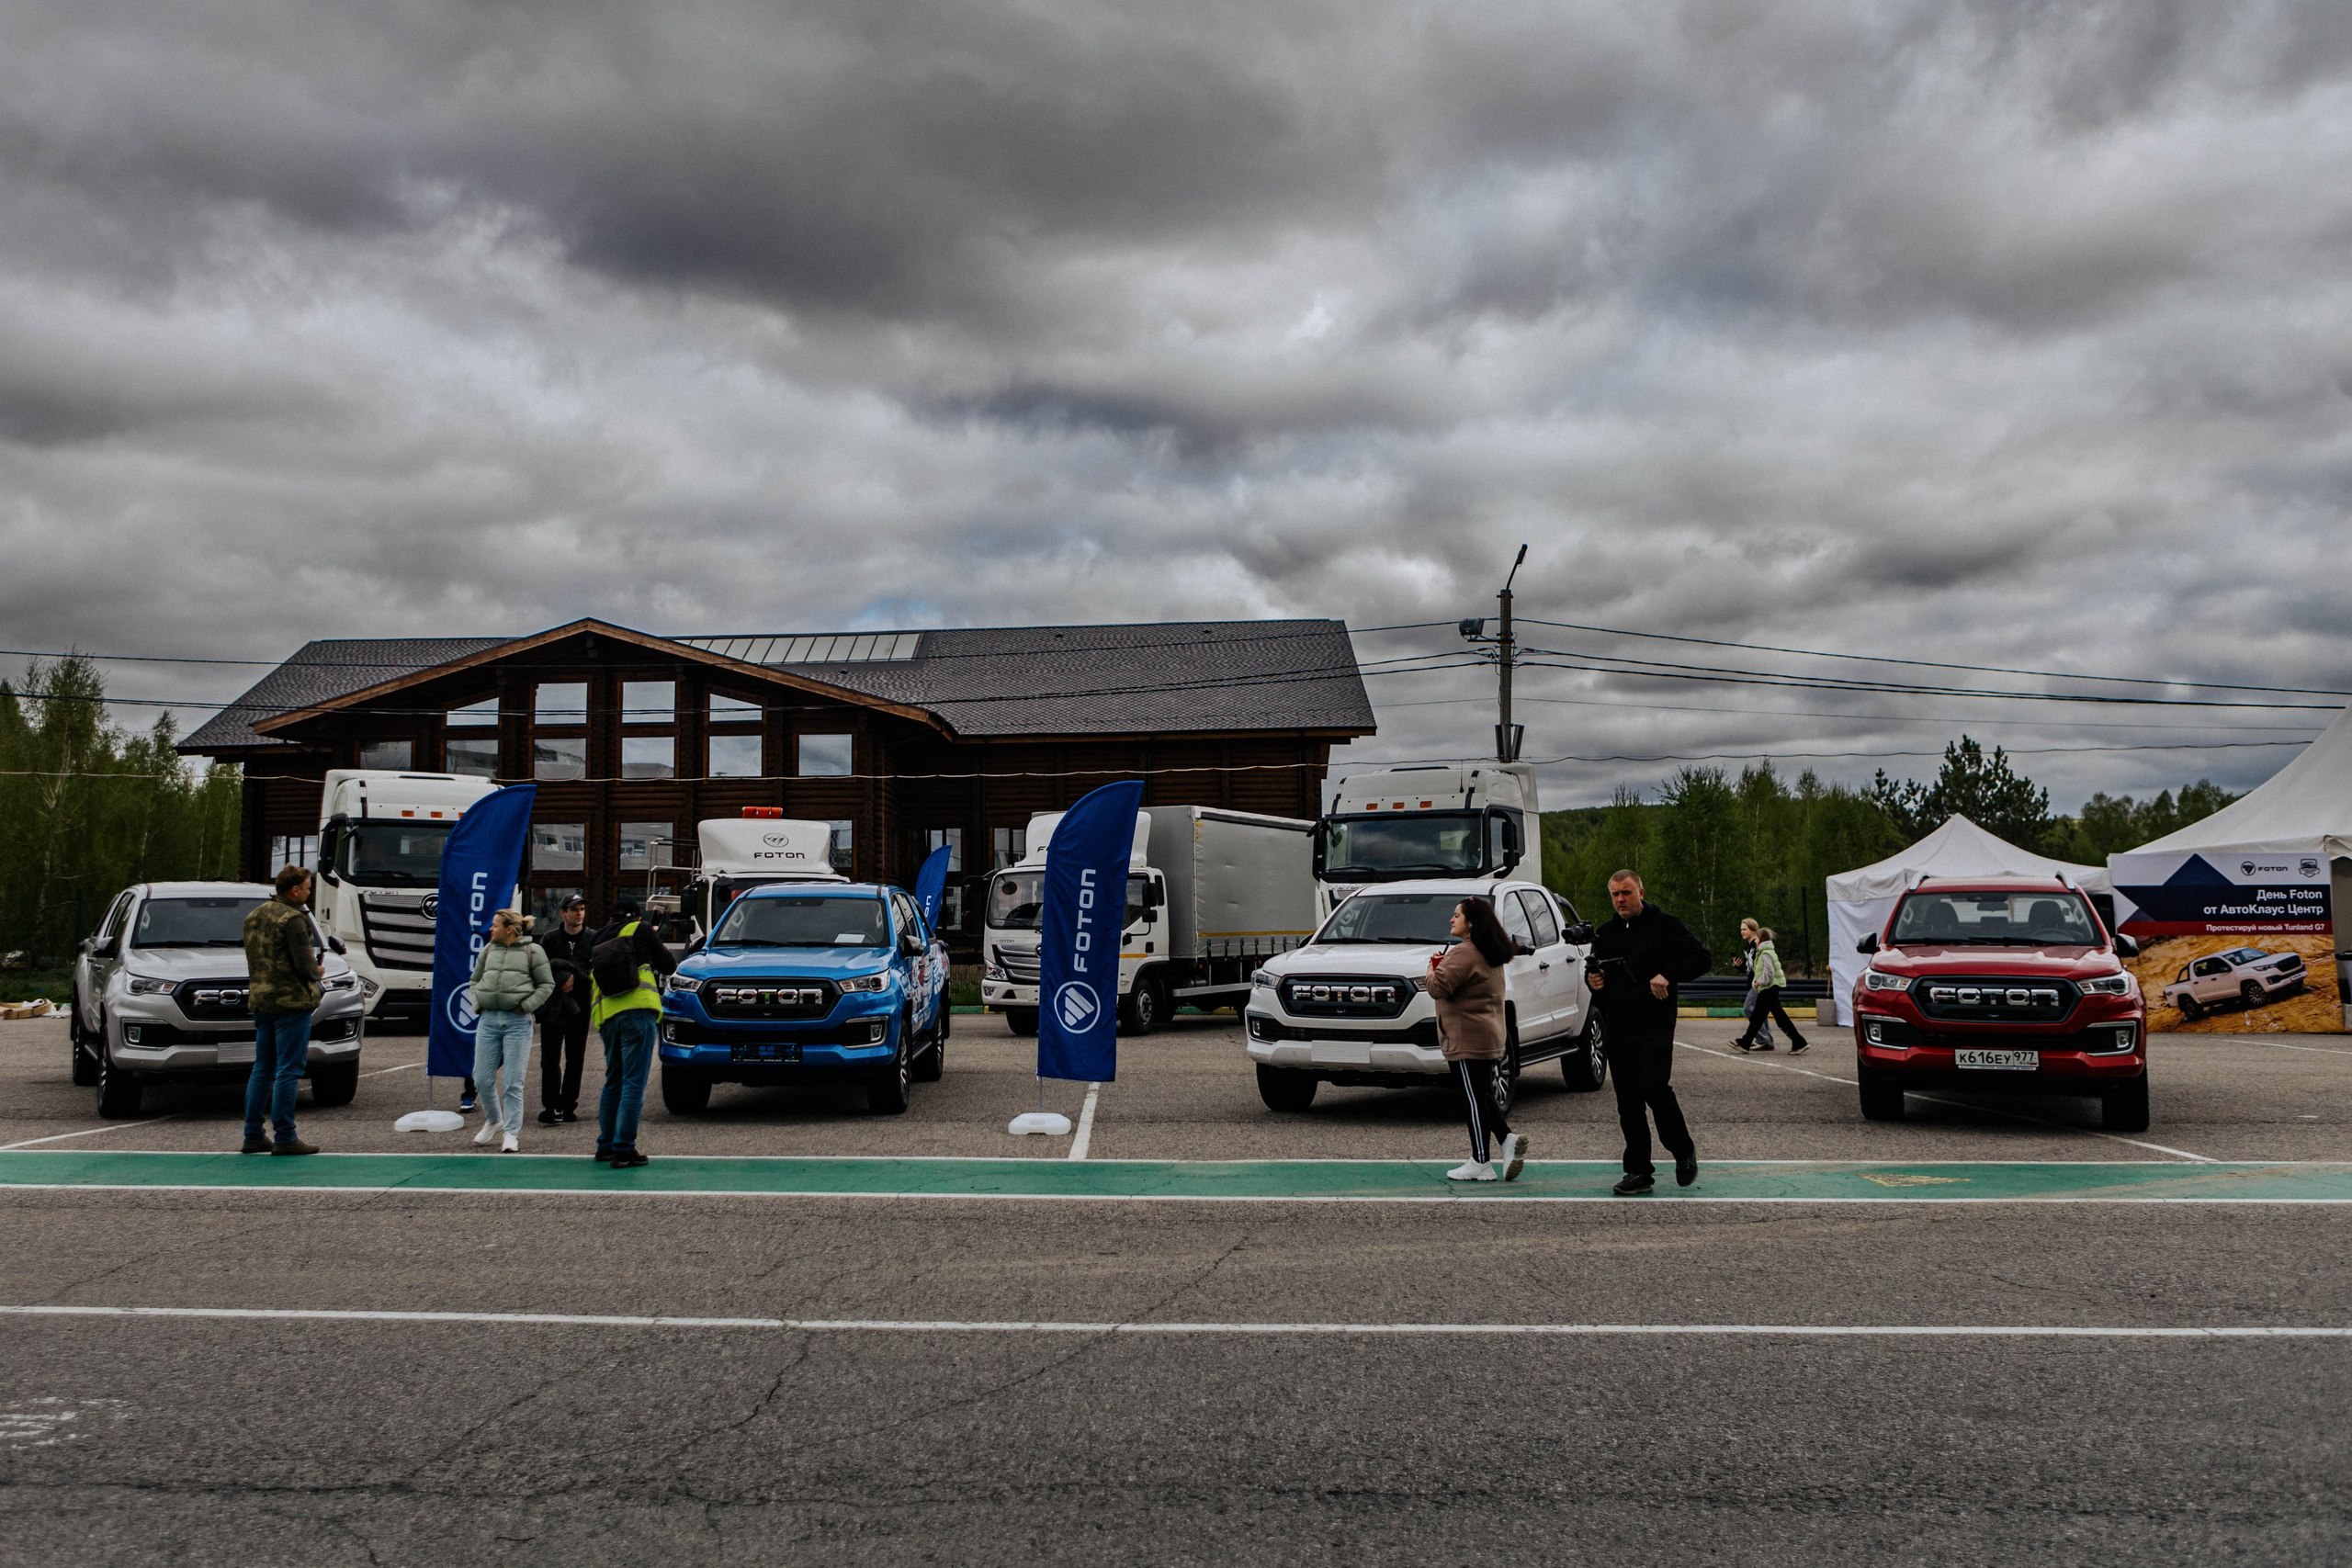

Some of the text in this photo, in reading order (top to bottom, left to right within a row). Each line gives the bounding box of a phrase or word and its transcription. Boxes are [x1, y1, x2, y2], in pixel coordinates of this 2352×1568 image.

[754, 852, 805, 860] FOTON
[2256, 889, 2324, 901] День Foton
[2203, 904, 2324, 916] от АвтоКлаус Центр
[1073, 868, 1097, 973] FOTON
[2206, 923, 2325, 932] Протестируй новый Tunland G7
[716, 988, 823, 1005] FOTON
[1292, 986, 1396, 1003] FOTON
[1929, 987, 2059, 1007] FOTON
[2014, 1051, 2034, 1062] 977
